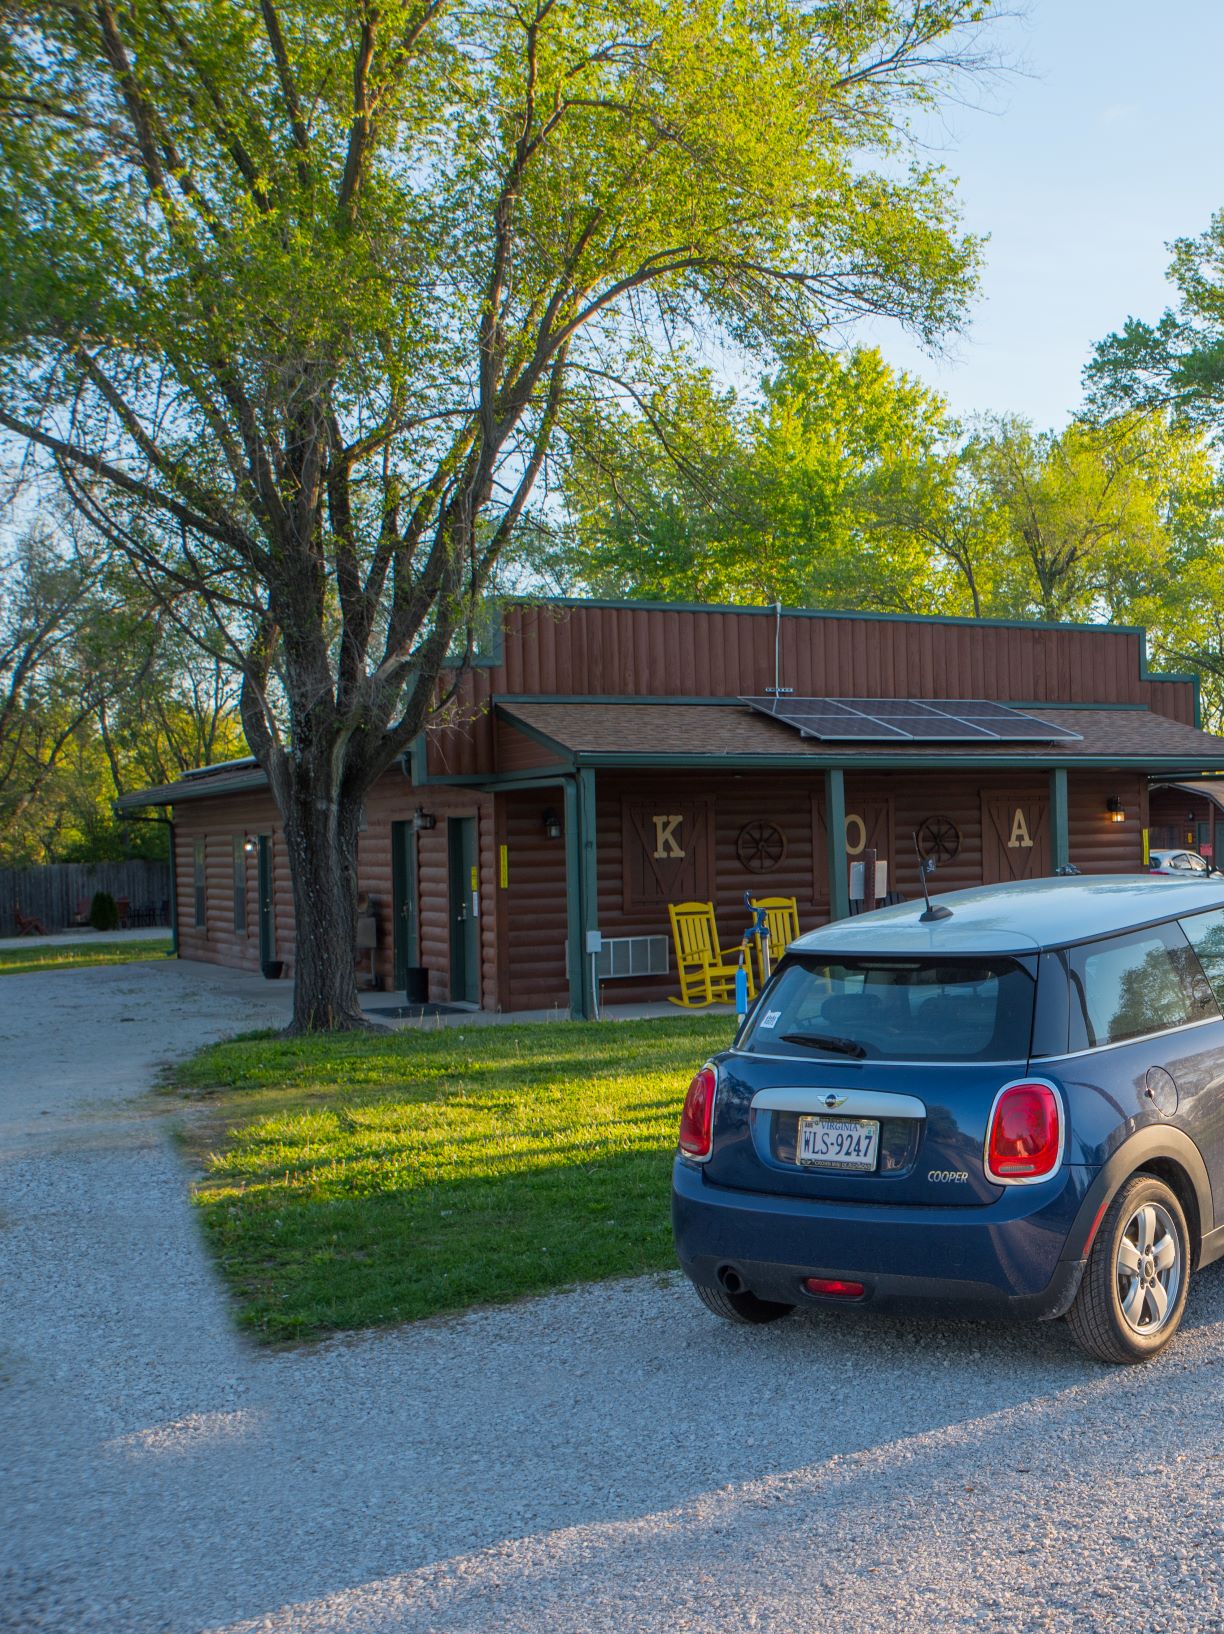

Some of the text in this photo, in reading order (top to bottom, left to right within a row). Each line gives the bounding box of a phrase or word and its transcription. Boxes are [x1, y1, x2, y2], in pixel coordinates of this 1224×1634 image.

[653, 808, 1034, 858] K O A
[821, 1121, 858, 1132] VIRGINIA
[804, 1130, 873, 1157] WLS-9247
[927, 1170, 969, 1184] COOPER
